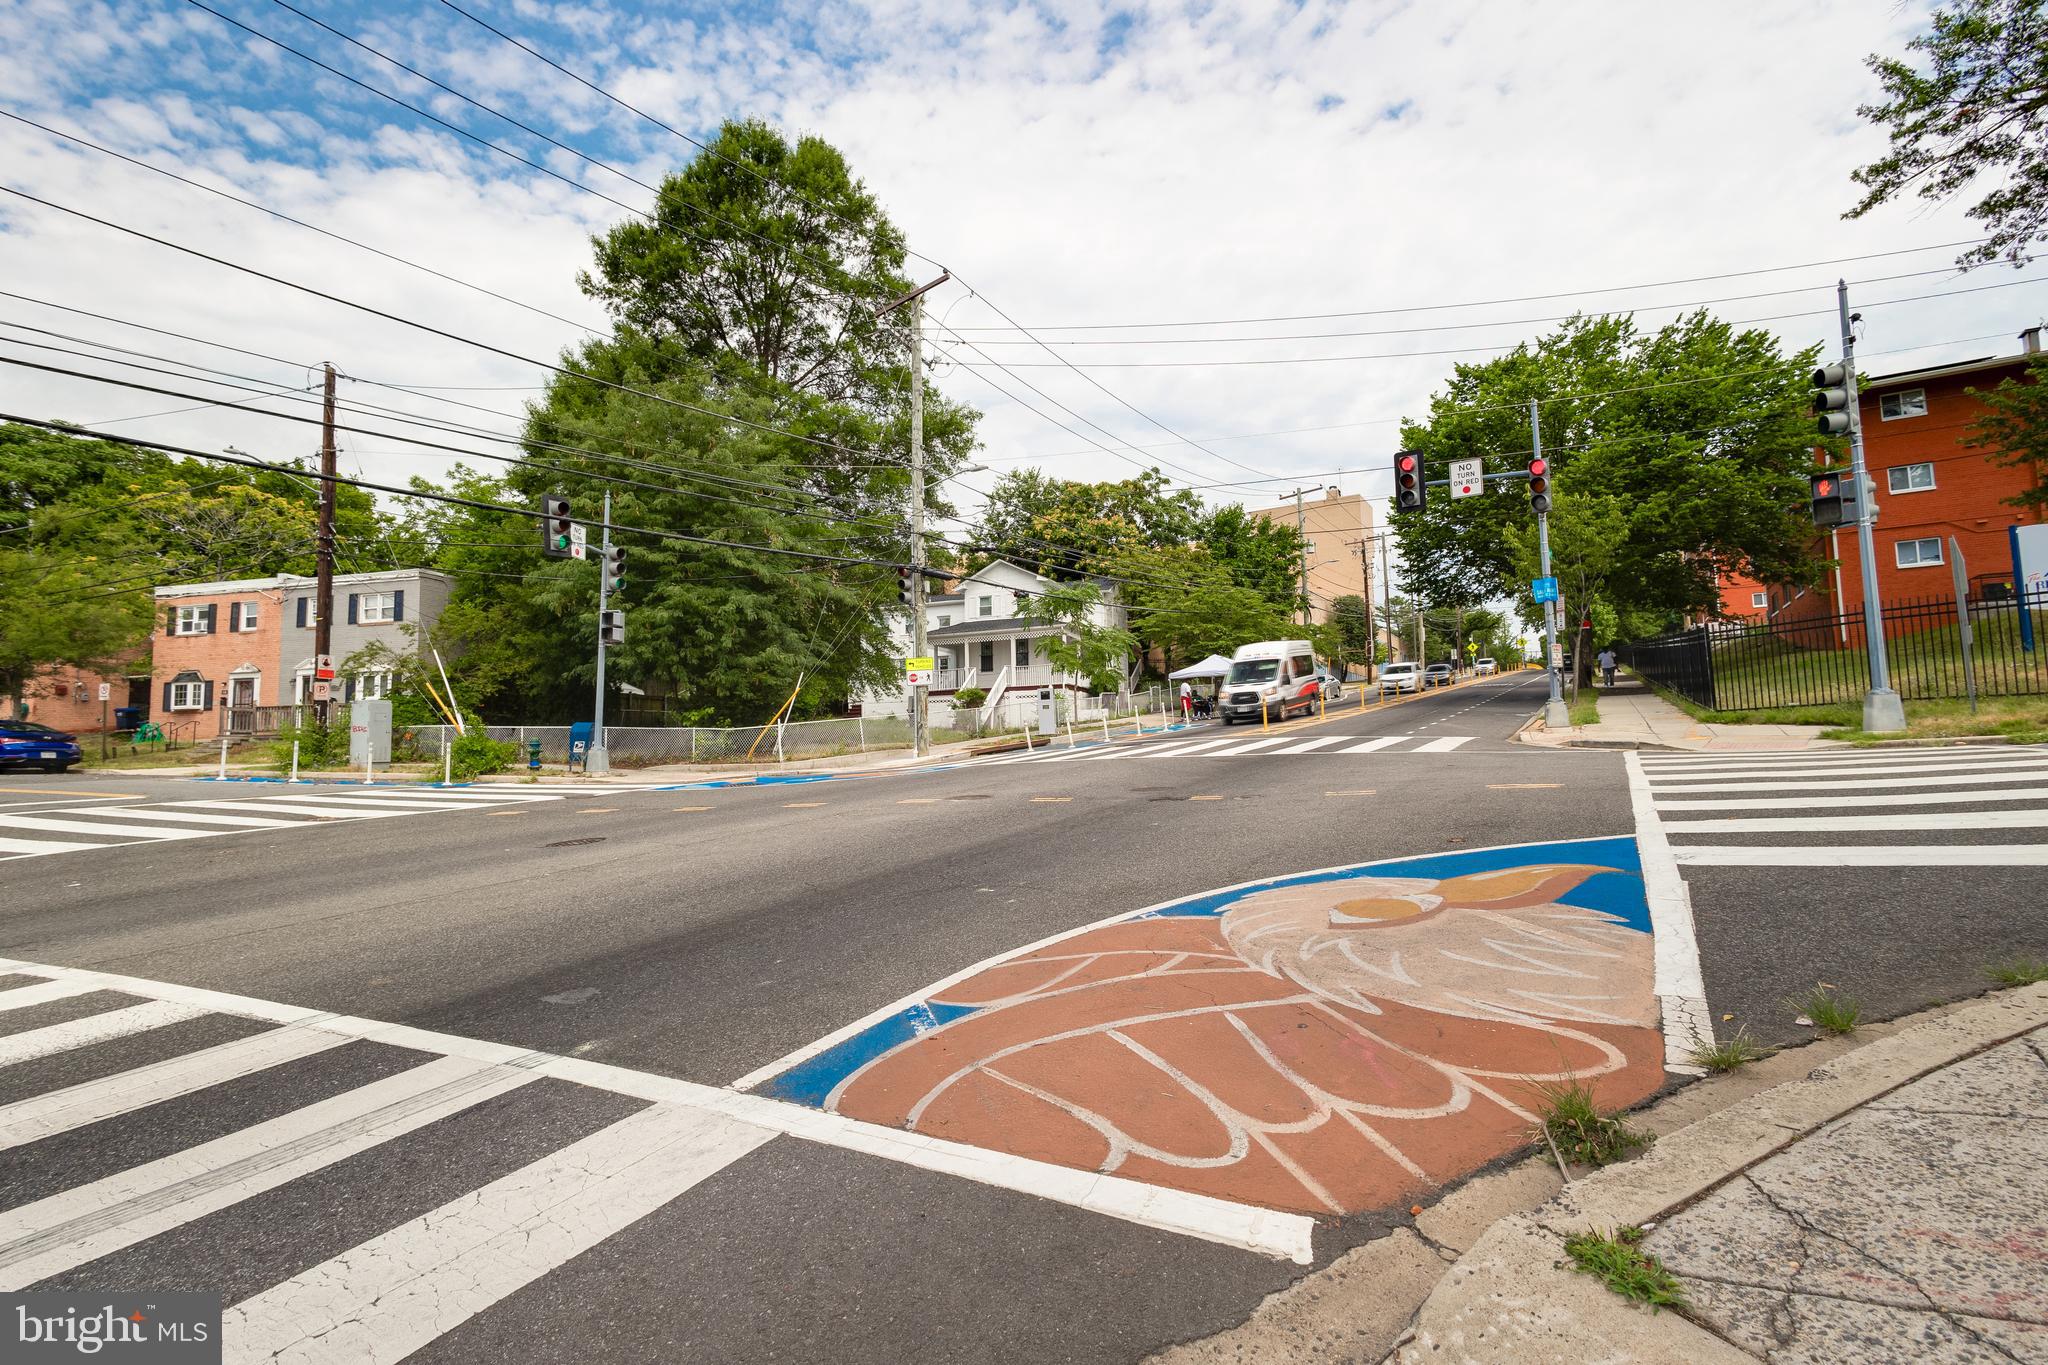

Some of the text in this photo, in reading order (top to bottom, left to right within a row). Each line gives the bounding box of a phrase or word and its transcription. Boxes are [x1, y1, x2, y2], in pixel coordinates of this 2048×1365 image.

[1458, 463, 1472, 471] NO
[1457, 471, 1475, 479] TURN
[1465, 477, 1480, 485] RED
